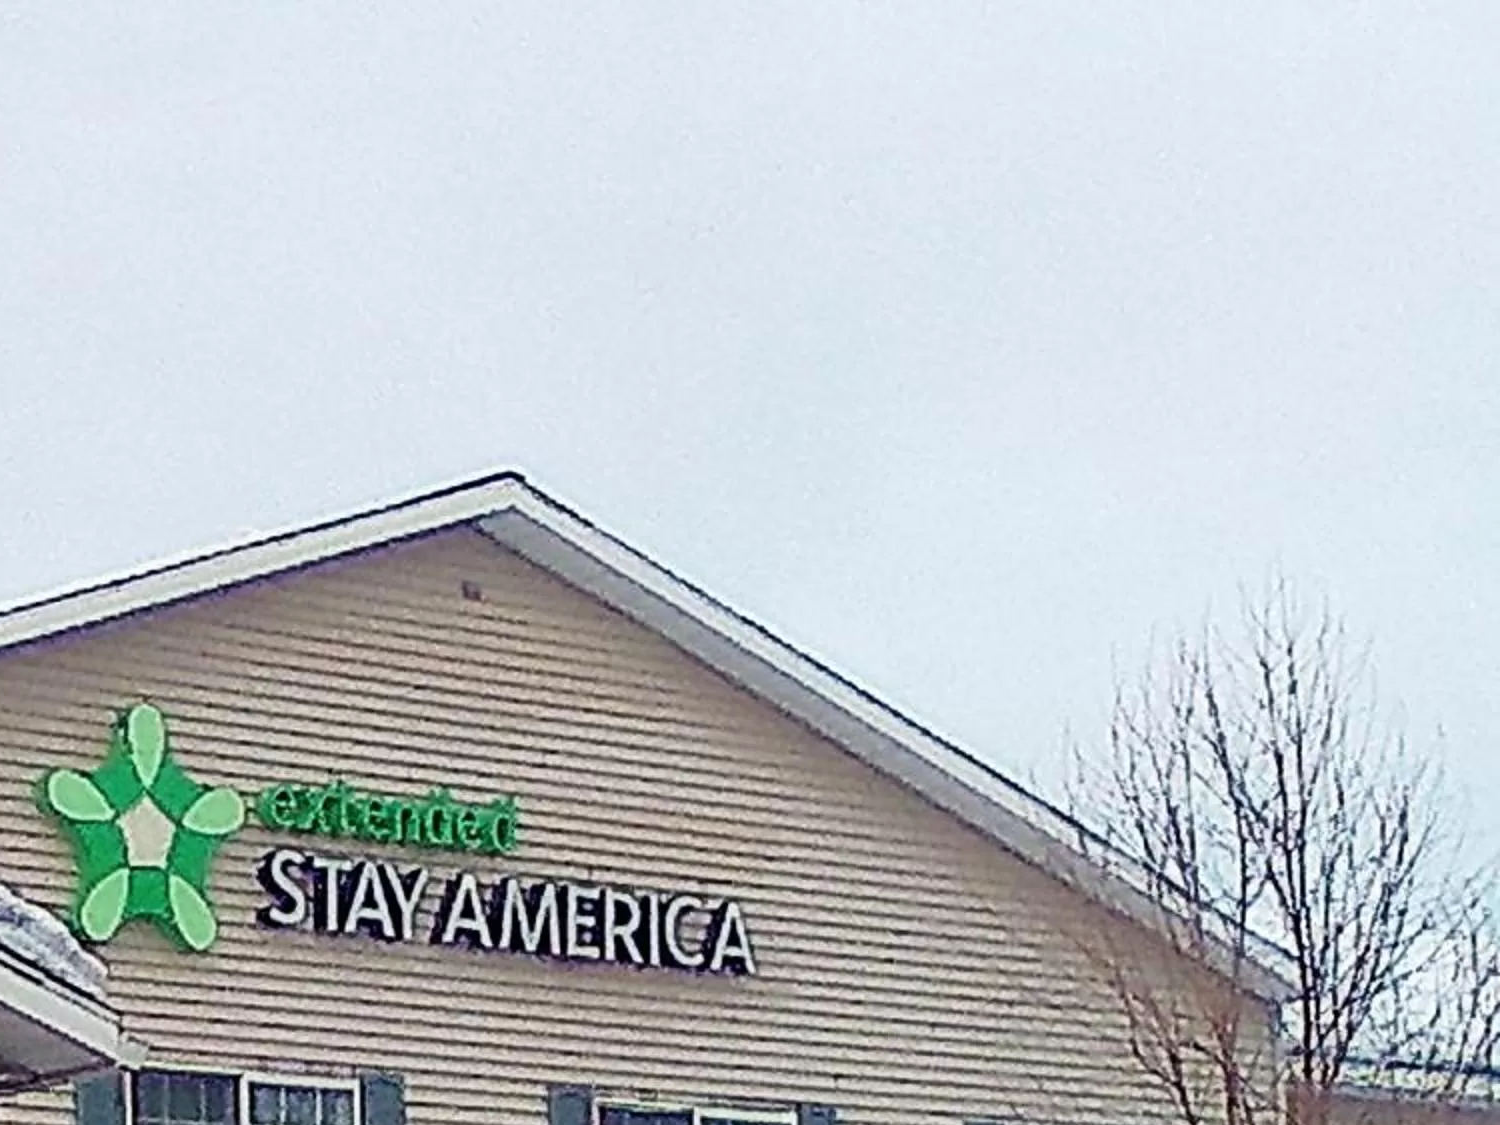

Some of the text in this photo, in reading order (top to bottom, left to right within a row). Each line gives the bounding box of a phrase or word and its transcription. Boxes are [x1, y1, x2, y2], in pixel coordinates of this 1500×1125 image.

[266, 784, 519, 852] extended
[265, 850, 757, 974] STAY AMERICA
